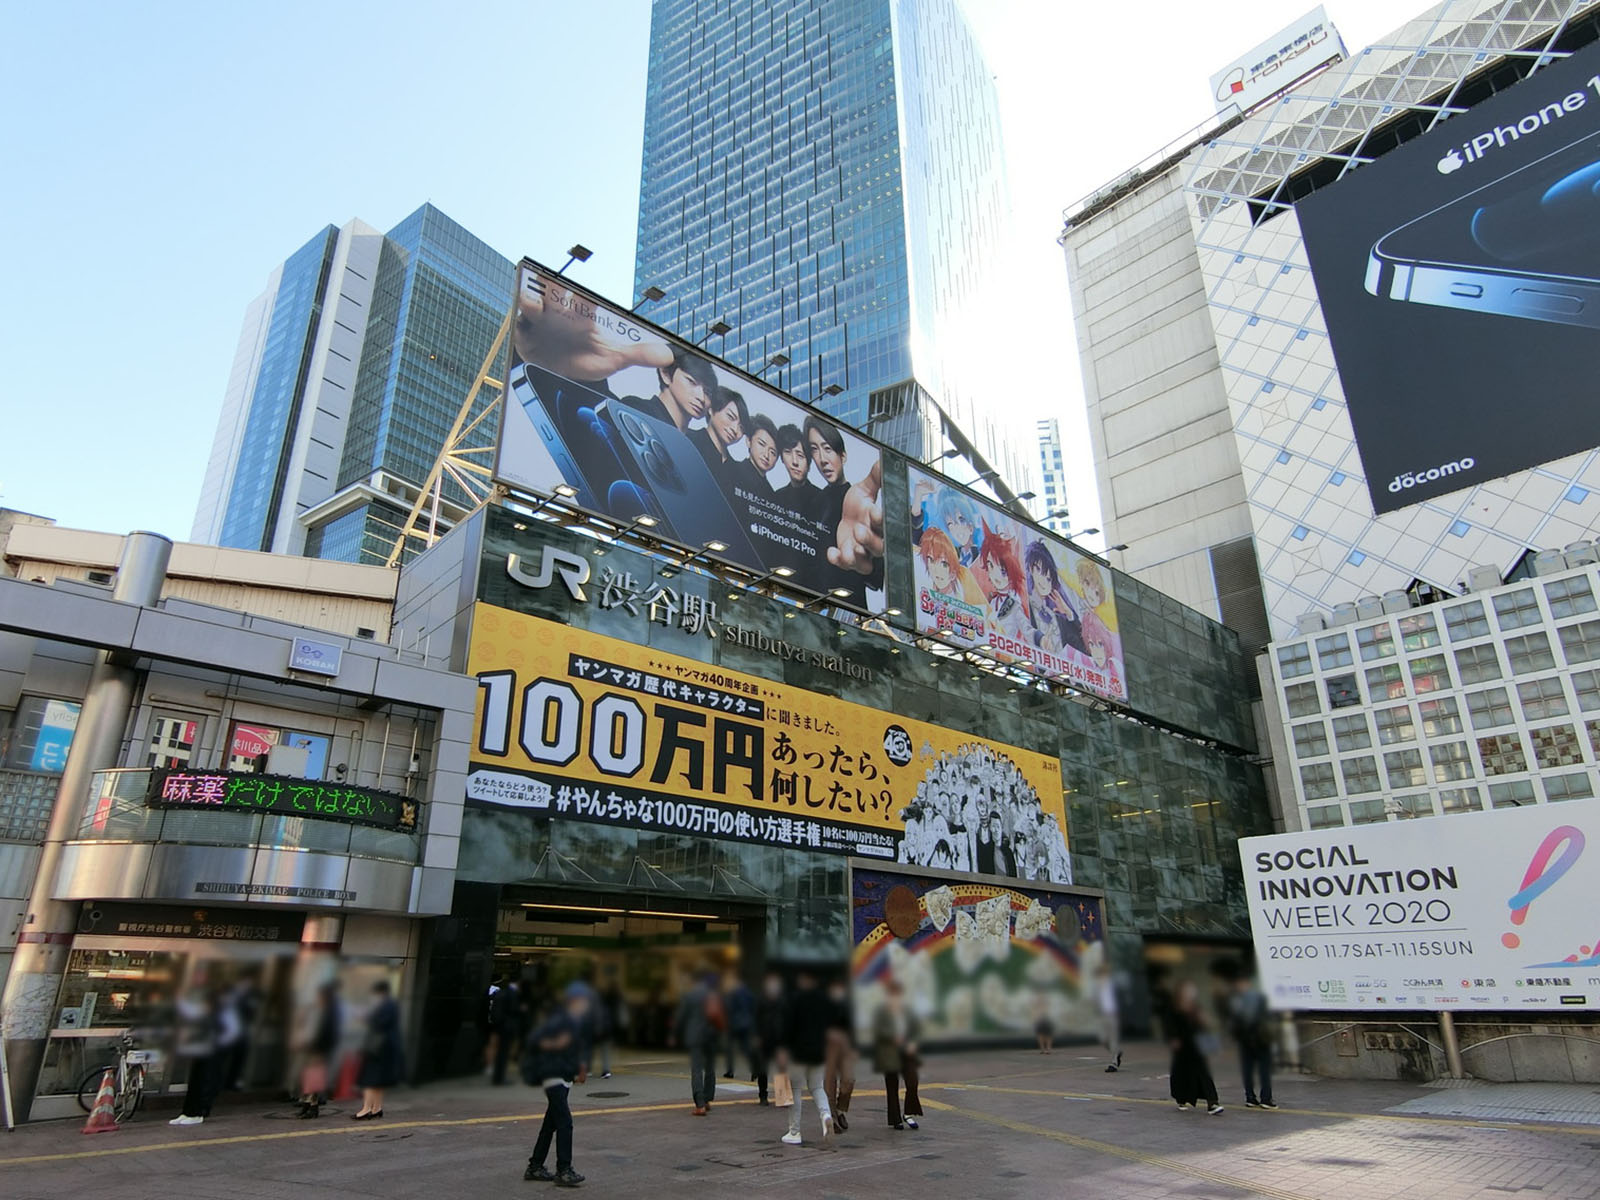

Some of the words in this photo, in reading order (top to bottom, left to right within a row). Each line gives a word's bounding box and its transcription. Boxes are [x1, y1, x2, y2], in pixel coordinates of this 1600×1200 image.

[1246, 31, 1328, 84] TOKYU
[1463, 91, 1586, 163] iPhone
[550, 288, 614, 331] SoftBank
[616, 321, 642, 342] 5G
[1388, 457, 1475, 493] docomo
[758, 525, 790, 546] iPhone
[791, 538, 801, 550] 12
[801, 542, 816, 556] Pro
[506, 544, 591, 602] JR
[600, 567, 718, 639] 渋谷駅
[726, 624, 808, 664] shibuya
[812, 654, 873, 683] station
[575, 658, 761, 714] ヤンマガ歴代キャラクター
[767, 707, 840, 736] に聞きました。
[675, 665, 759, 695] ヤンマガ40周年企画
[475, 669, 765, 800] 100万円
[771, 731, 891, 785] あったら、
[163, 773, 396, 816] 麻薬だけではない。
[473, 776, 548, 794] あなたならどう使う?
[770, 767, 893, 821] 何したい?
[556, 785, 821, 847] #やんちゃな100万円の使い方選手権
[1255, 844, 1369, 872] SOCIAL
[202, 882, 288, 896] SHIBUYA-EKIMAE
[297, 887, 329, 899] POLICE
[334, 891, 351, 901] BOX
[1259, 866, 1459, 900] INNOVATION
[1263, 904, 1356, 929] WEEK
[1365, 899, 1451, 925] 2020
[1269, 945, 1318, 959] 2020
[1324, 940, 1474, 958] 11.7SAT-11.15SUN
[1374, 979, 1388, 988] 5G
[1474, 979, 1496, 987] 東急
